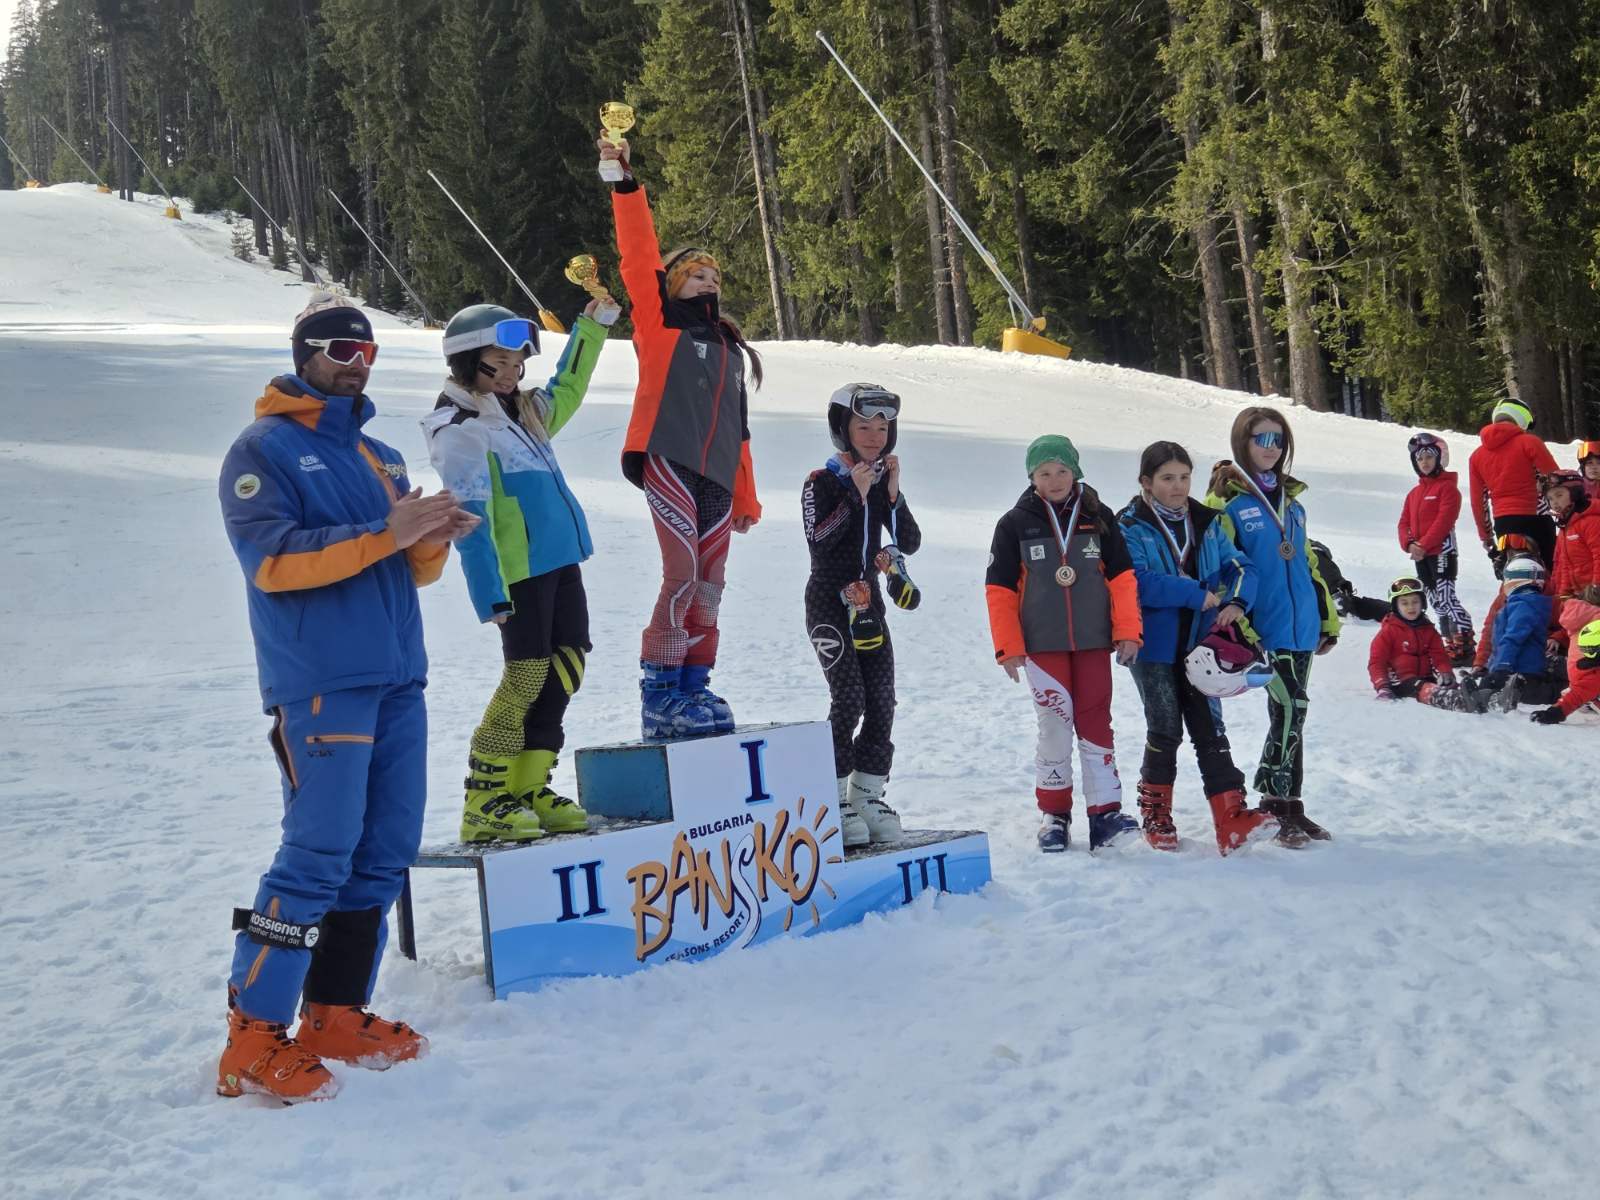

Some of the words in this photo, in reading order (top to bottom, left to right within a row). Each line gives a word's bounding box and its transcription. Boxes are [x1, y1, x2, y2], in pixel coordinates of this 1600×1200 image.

[740, 740, 772, 804] I
[464, 811, 513, 830] FISCHER
[689, 813, 754, 840] BULGARIA
[552, 860, 607, 923] II
[626, 809, 821, 963] BANSKO
[897, 853, 952, 905] III
[713, 911, 745, 947] RESORT
